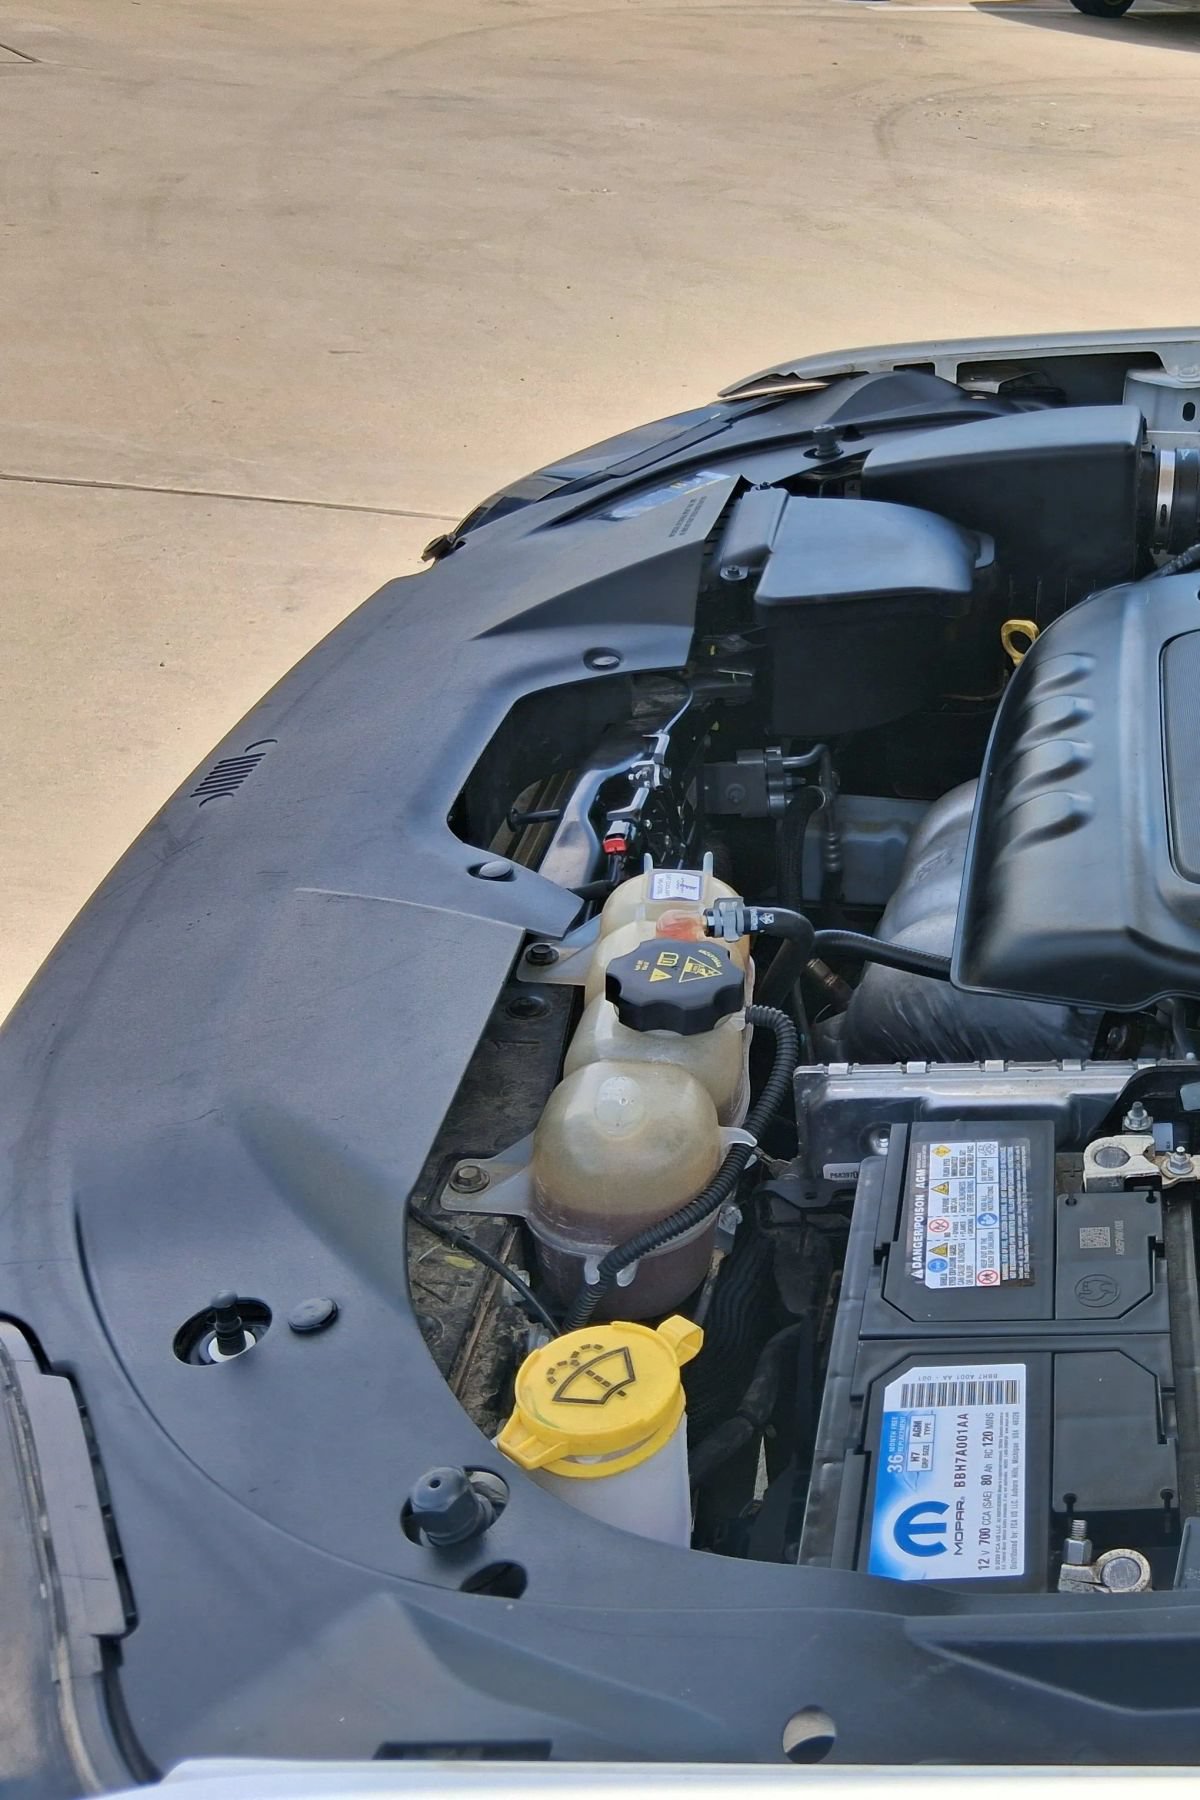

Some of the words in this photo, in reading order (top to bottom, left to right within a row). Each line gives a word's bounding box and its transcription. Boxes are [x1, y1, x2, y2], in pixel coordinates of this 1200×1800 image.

[915, 1169, 926, 1188] AGM
[912, 1194, 925, 1268] DANGER/POISON
[912, 1420, 922, 1438] AGM
[888, 1431, 897, 1452] MONTH
[982, 1431, 993, 1447] 120
[910, 1452, 920, 1462] H7
[954, 1413, 968, 1488] BBH7A001AA
[984, 1449, 993, 1458] RC
[887, 1454, 904, 1473] 36
[983, 1464, 992, 1472] Ah
[980, 1474, 992, 1486] 80
[982, 1491, 993, 1509] (SAE)
[982, 1511, 992, 1526] CCA
[953, 1500, 965, 1556] MOPAR
[978, 1528, 991, 1545] 700
[978, 1558, 990, 1570] 12
